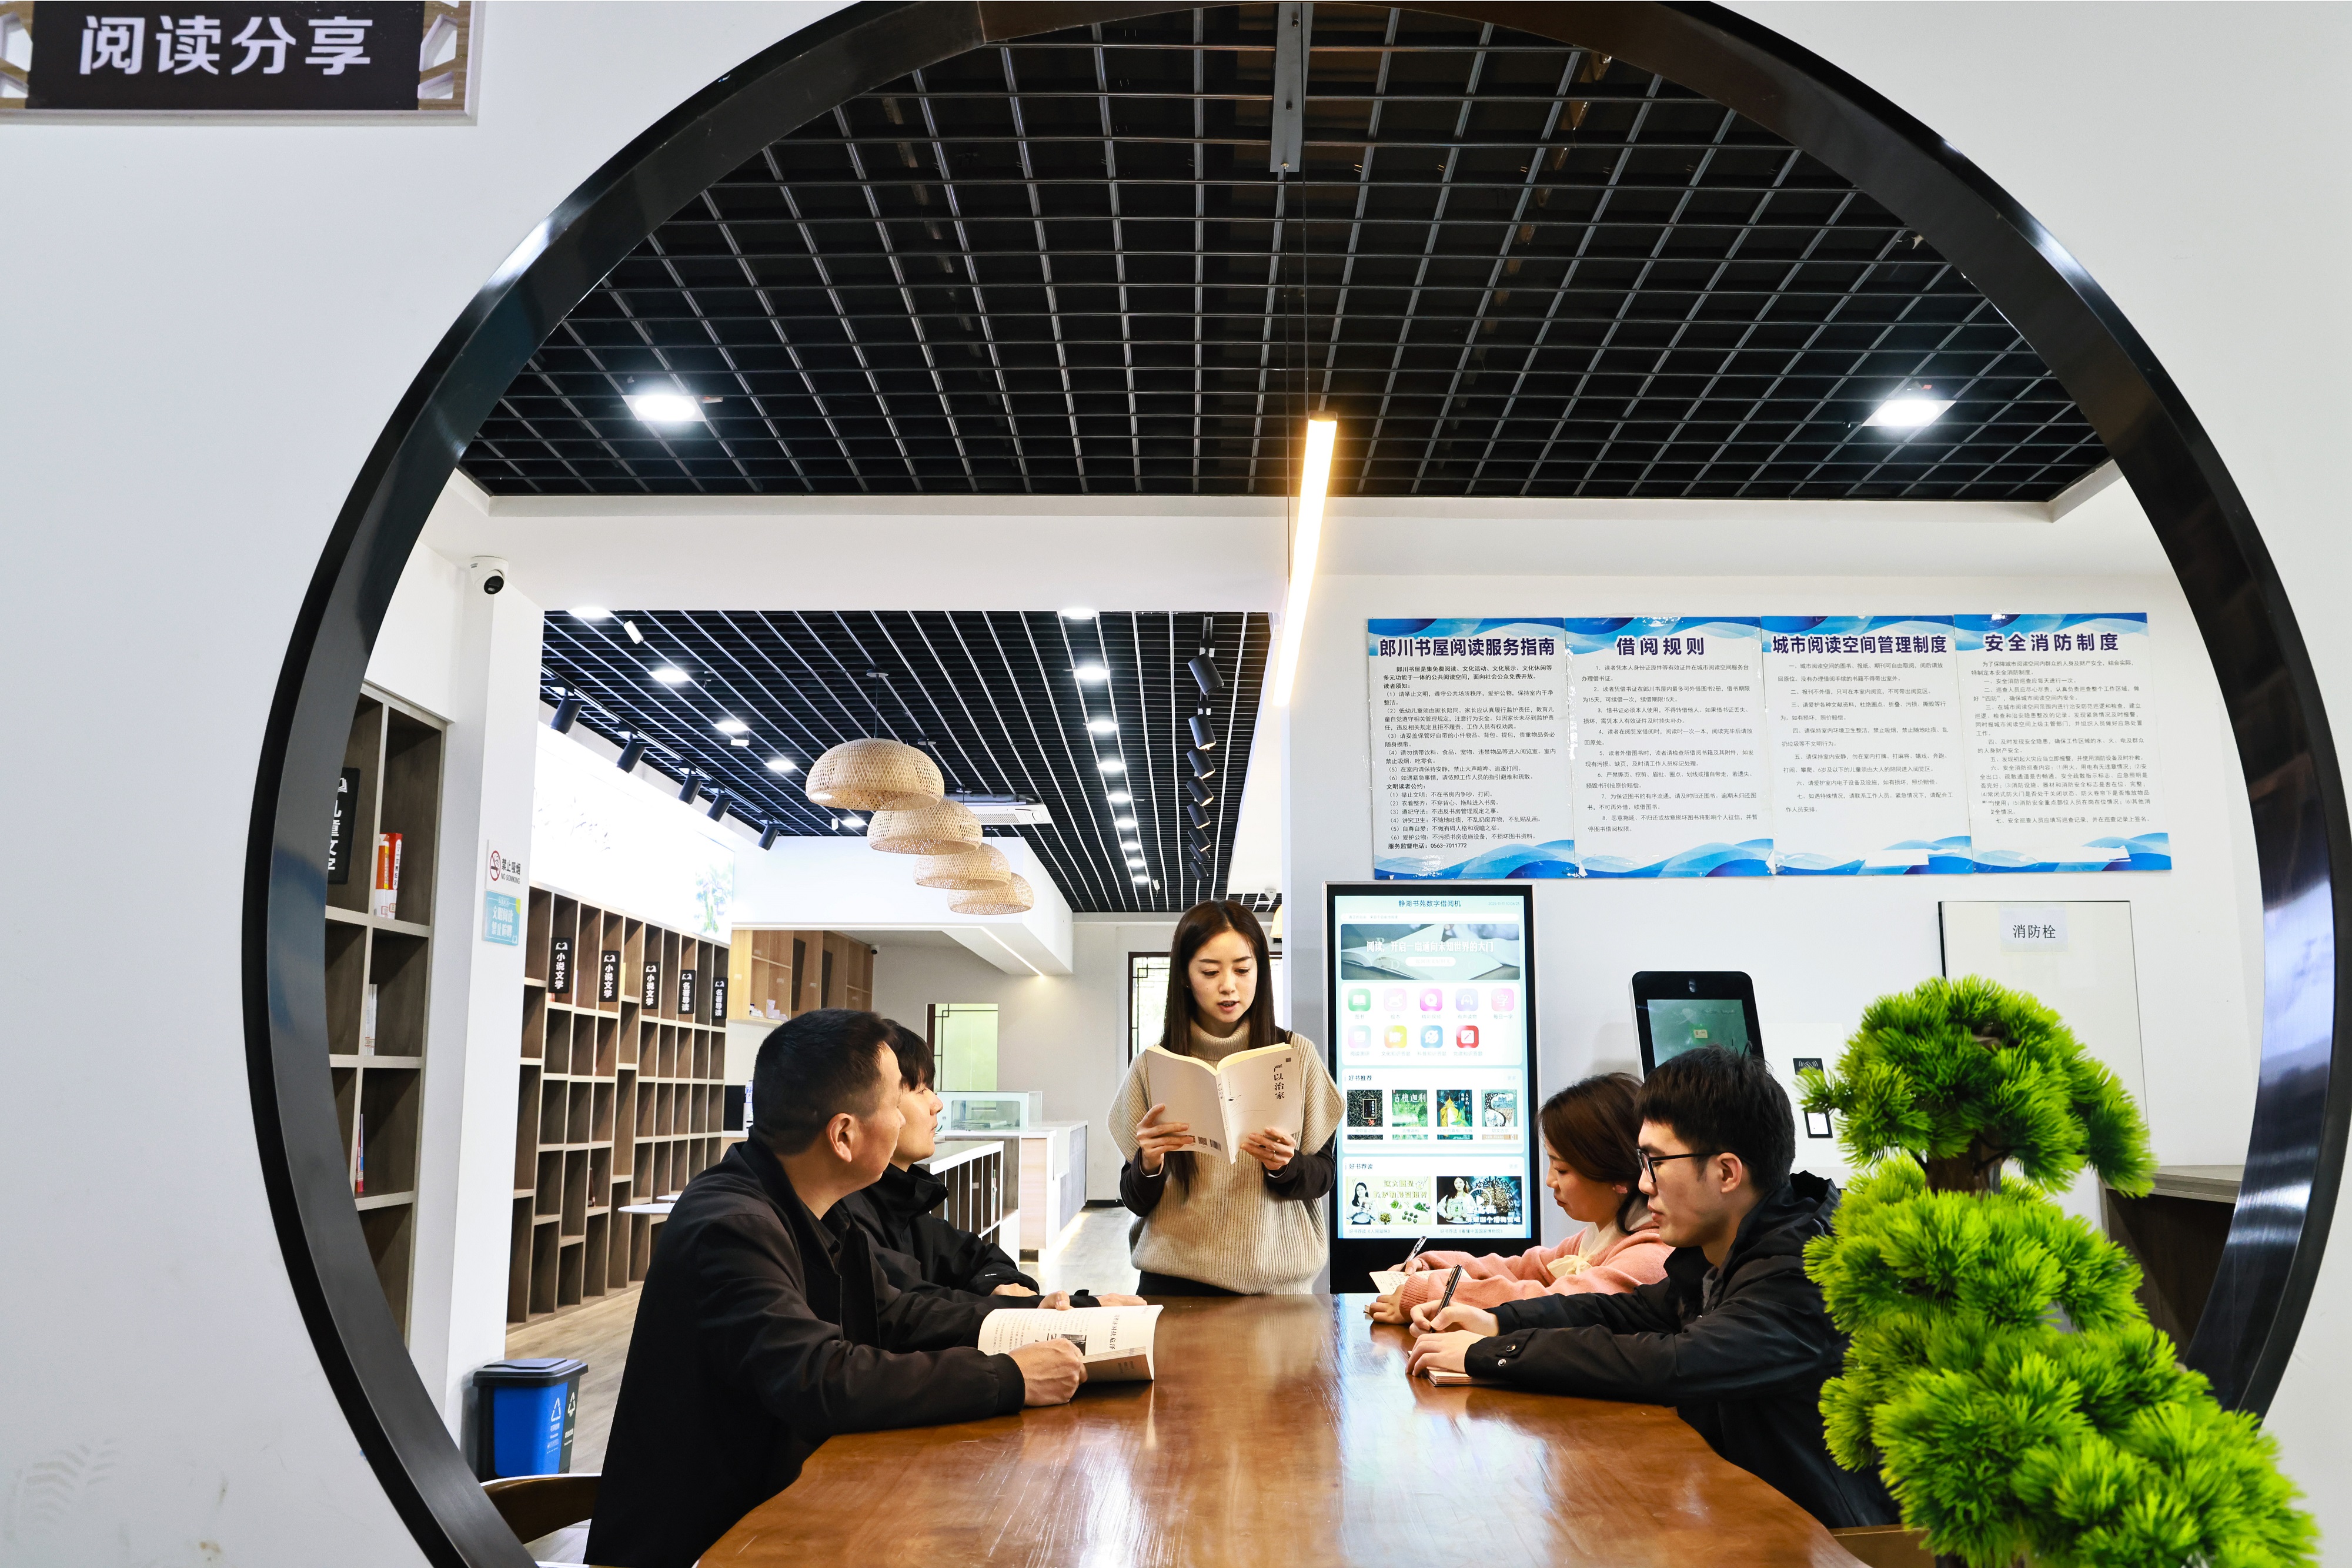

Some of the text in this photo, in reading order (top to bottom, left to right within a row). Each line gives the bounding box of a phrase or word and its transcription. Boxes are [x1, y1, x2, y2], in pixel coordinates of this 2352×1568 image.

[79, 16, 373, 75] 阅读分享
[1379, 638, 1555, 657] 郎川书屋阅读服务指南
[1617, 637, 1705, 655] 借阅规则
[1773, 636, 1947, 654] 城市阅读空间管理制度
[1985, 633, 2119, 651] 安全消防制度
[502, 858, 521, 875] 禁止吸烟
[2013, 924, 2056, 938] 消防栓
[555, 952, 565, 989] 小说文学
[604, 965, 613, 998] 小说文学
[646, 974, 654, 1006] 小说文学
[682, 982, 690, 1011] 名著导读
[1273, 1064, 1285, 1100] 严以治家
[1394, 1094, 1426, 1102] 吉檀迦利
